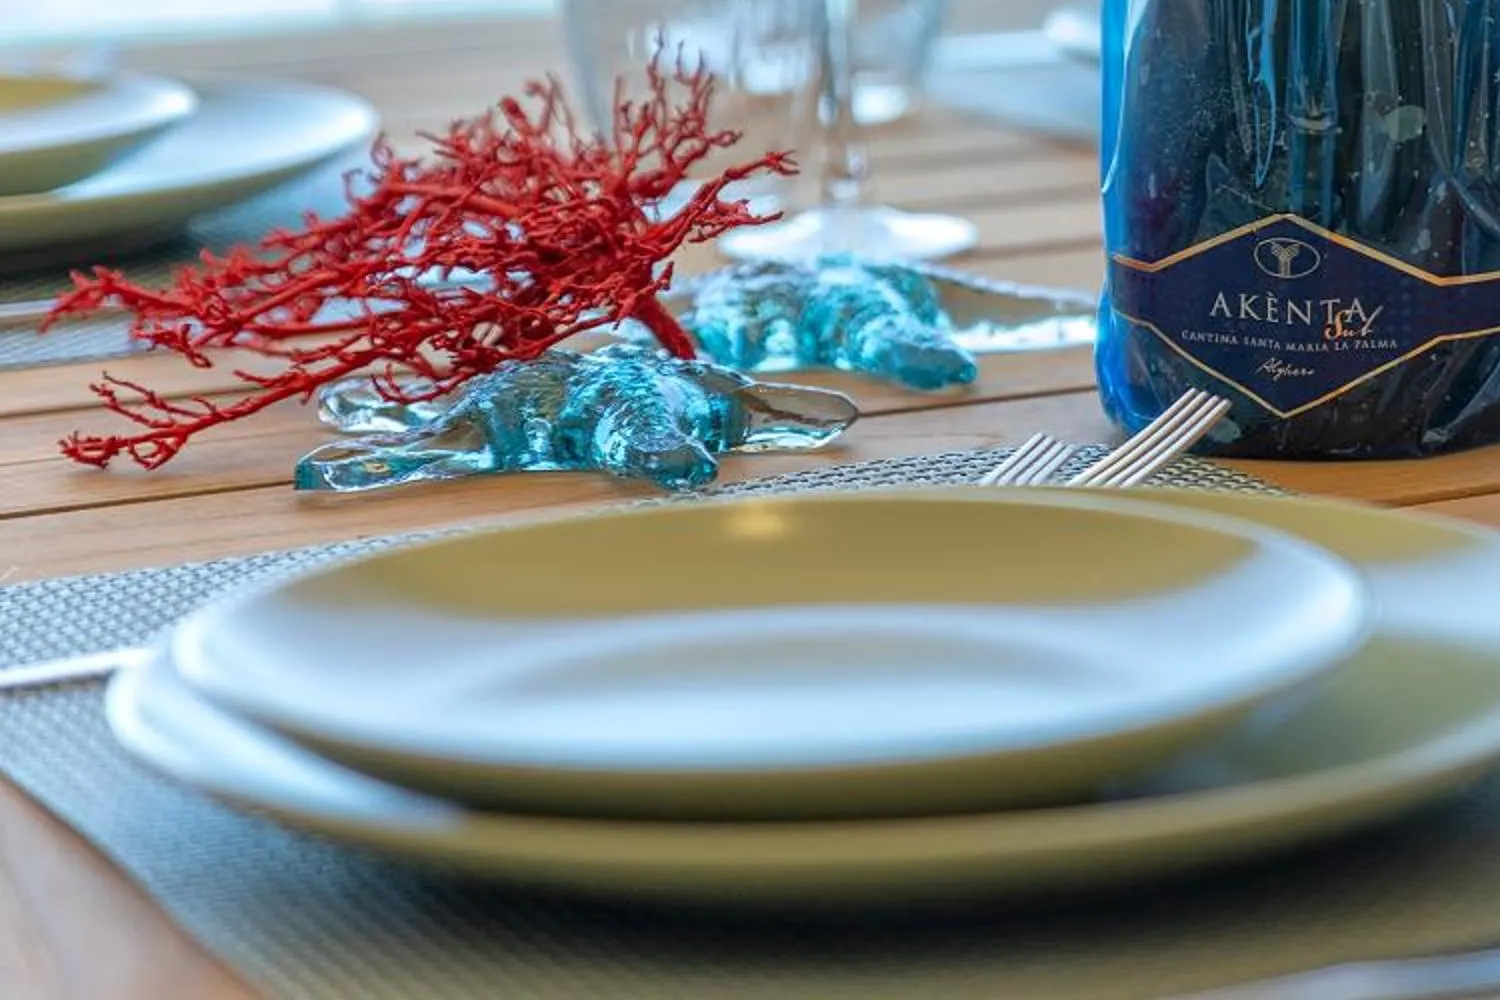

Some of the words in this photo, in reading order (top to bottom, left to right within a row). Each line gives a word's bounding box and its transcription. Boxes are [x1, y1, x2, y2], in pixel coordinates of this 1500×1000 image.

[1209, 291, 1367, 326] AKÈNTA
[1181, 329, 1238, 345] CANTINA
[1244, 335, 1281, 350] SANTA
[1285, 341, 1328, 352] MARIA
[1335, 340, 1349, 351] LA
[1355, 338, 1398, 350] PALMA
